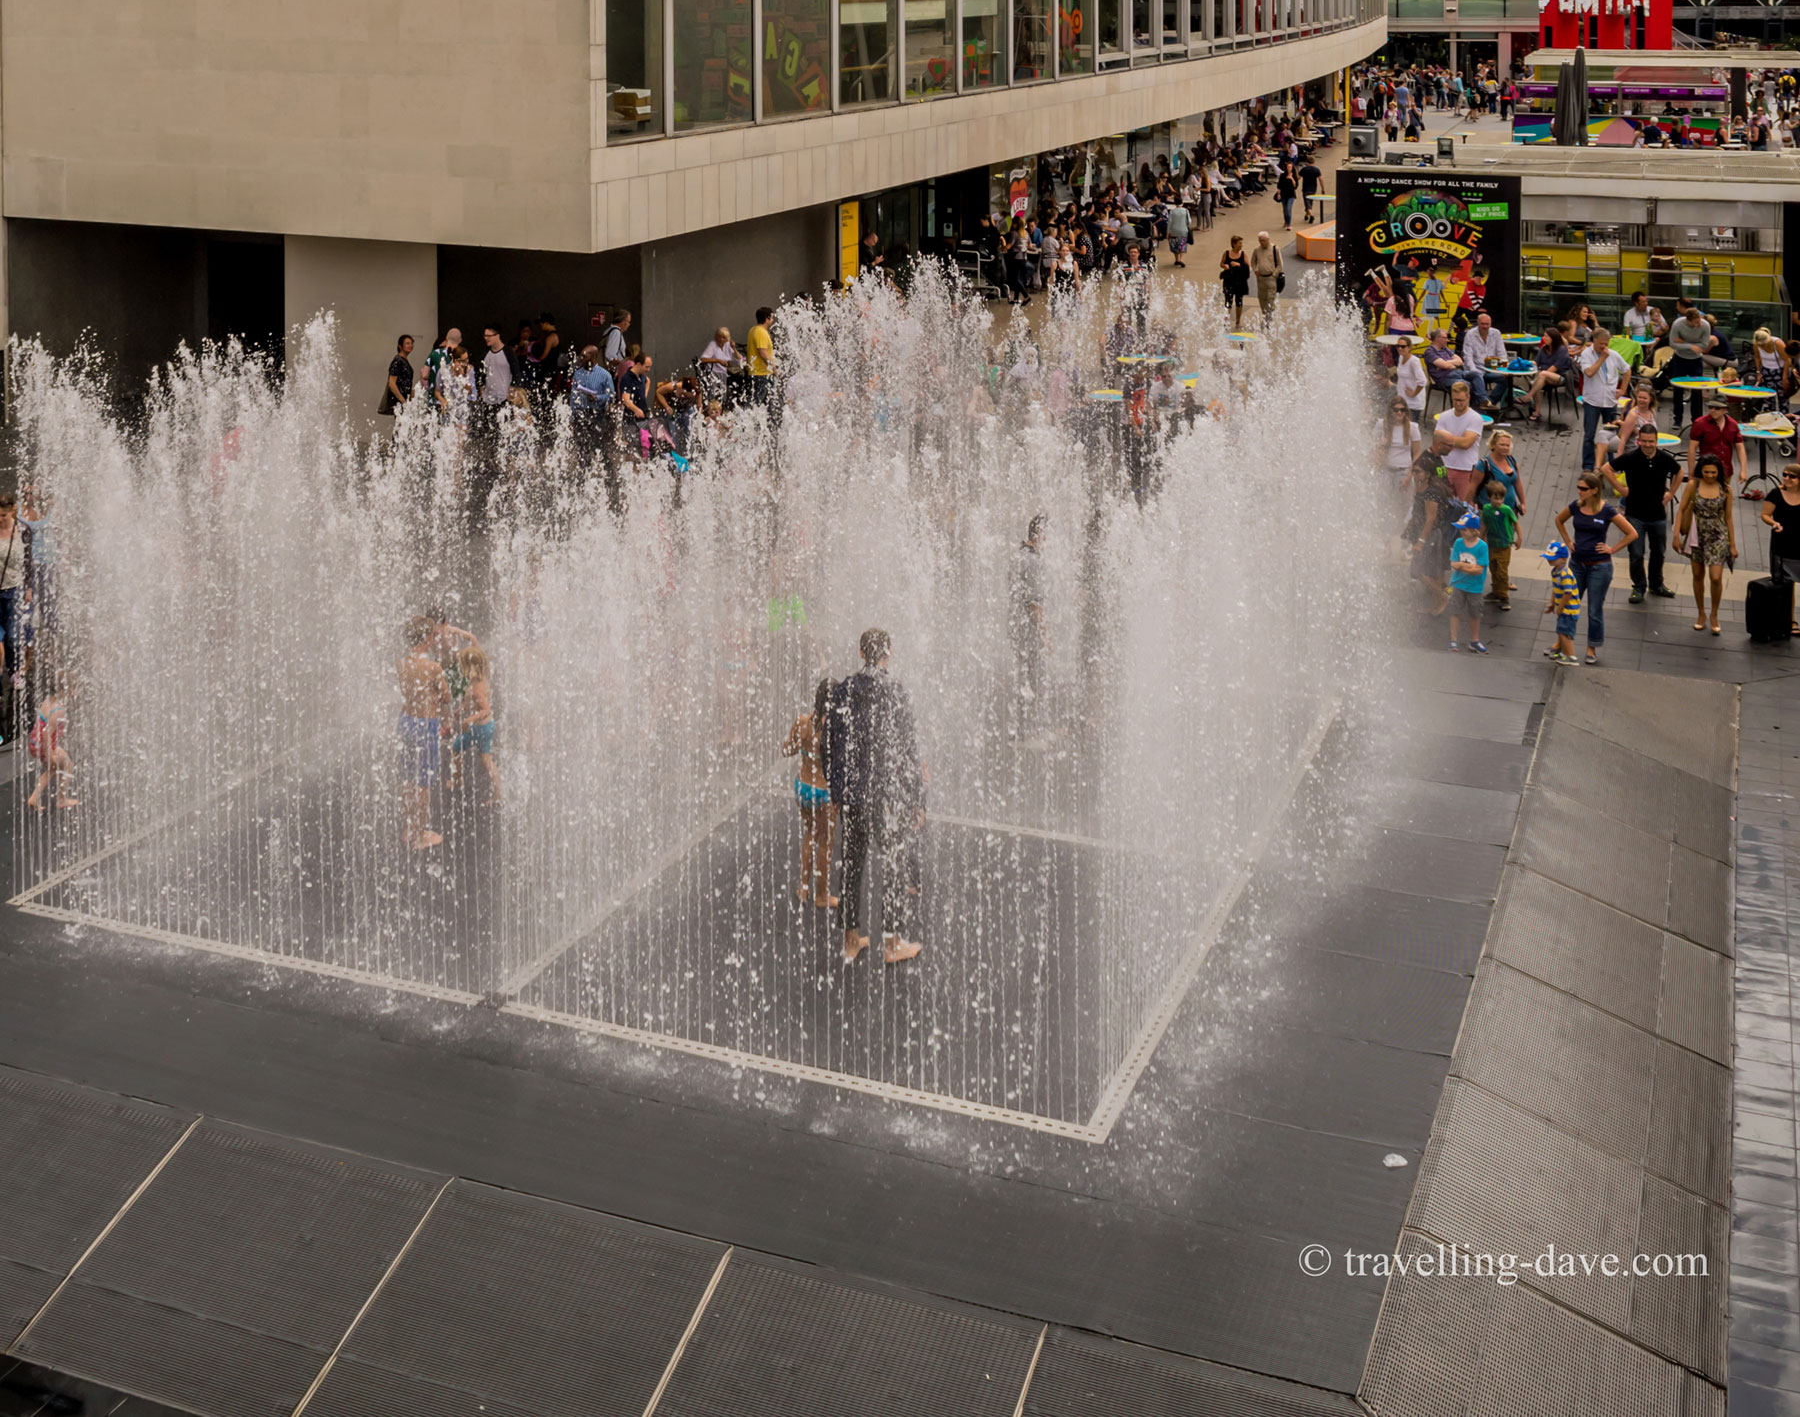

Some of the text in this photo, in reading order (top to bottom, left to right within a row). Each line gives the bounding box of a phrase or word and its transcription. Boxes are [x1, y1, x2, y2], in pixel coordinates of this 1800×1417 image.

[1371, 212, 1482, 248] GROOVE
[1438, 251, 1448, 259] OZ
[1440, 242, 1466, 256] ROAD
